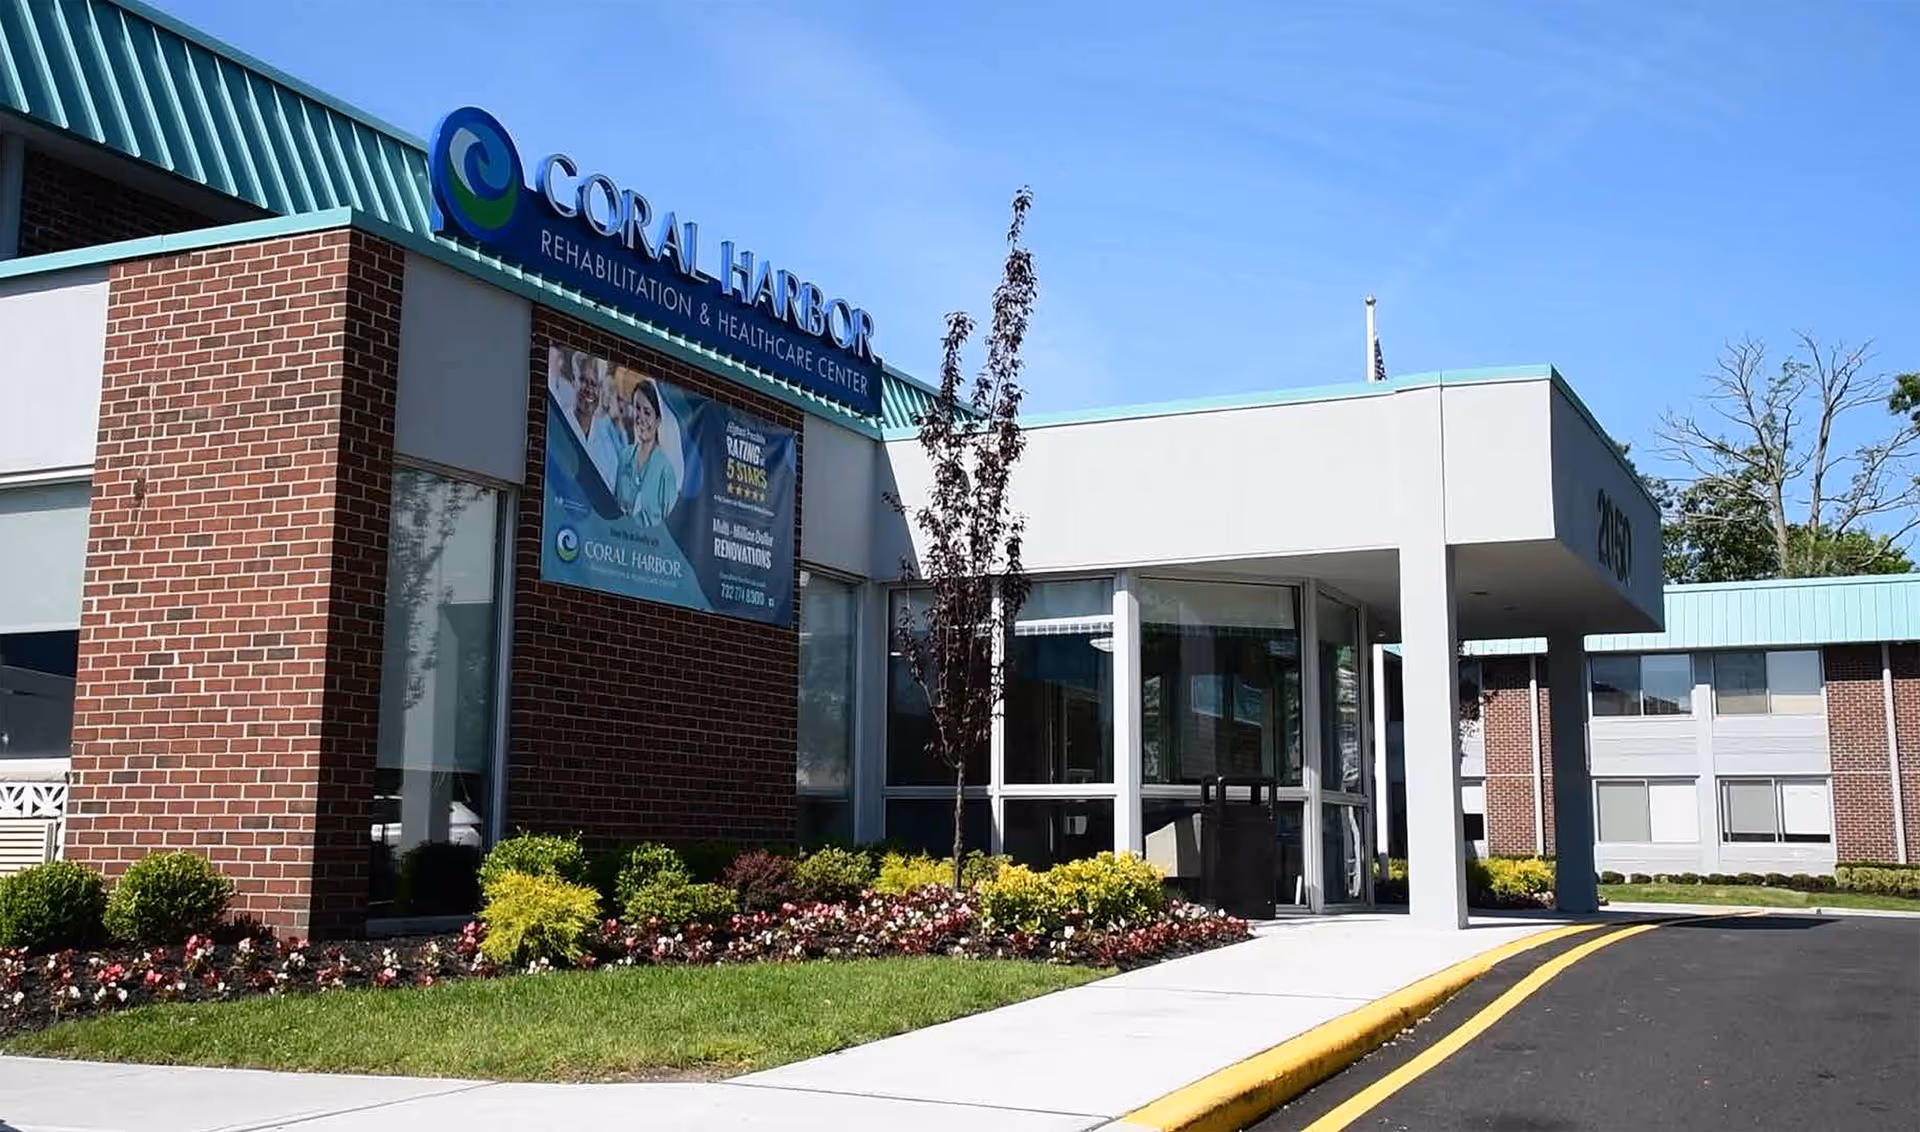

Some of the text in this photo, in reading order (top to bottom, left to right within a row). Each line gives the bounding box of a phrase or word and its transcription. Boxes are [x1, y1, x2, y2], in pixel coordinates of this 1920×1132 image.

[535, 154, 878, 364] CORAL HARBOR
[541, 229, 868, 396] REHABILITATION & HEALTHCARE CENTER
[726, 435, 760, 466] RATING
[726, 457, 768, 489] 5 STARS
[714, 537, 772, 570] RENOVATIONS
[1597, 486, 1632, 588] 2050
[585, 541, 628, 566] CORAL
[632, 551, 683, 578] HARBOR
